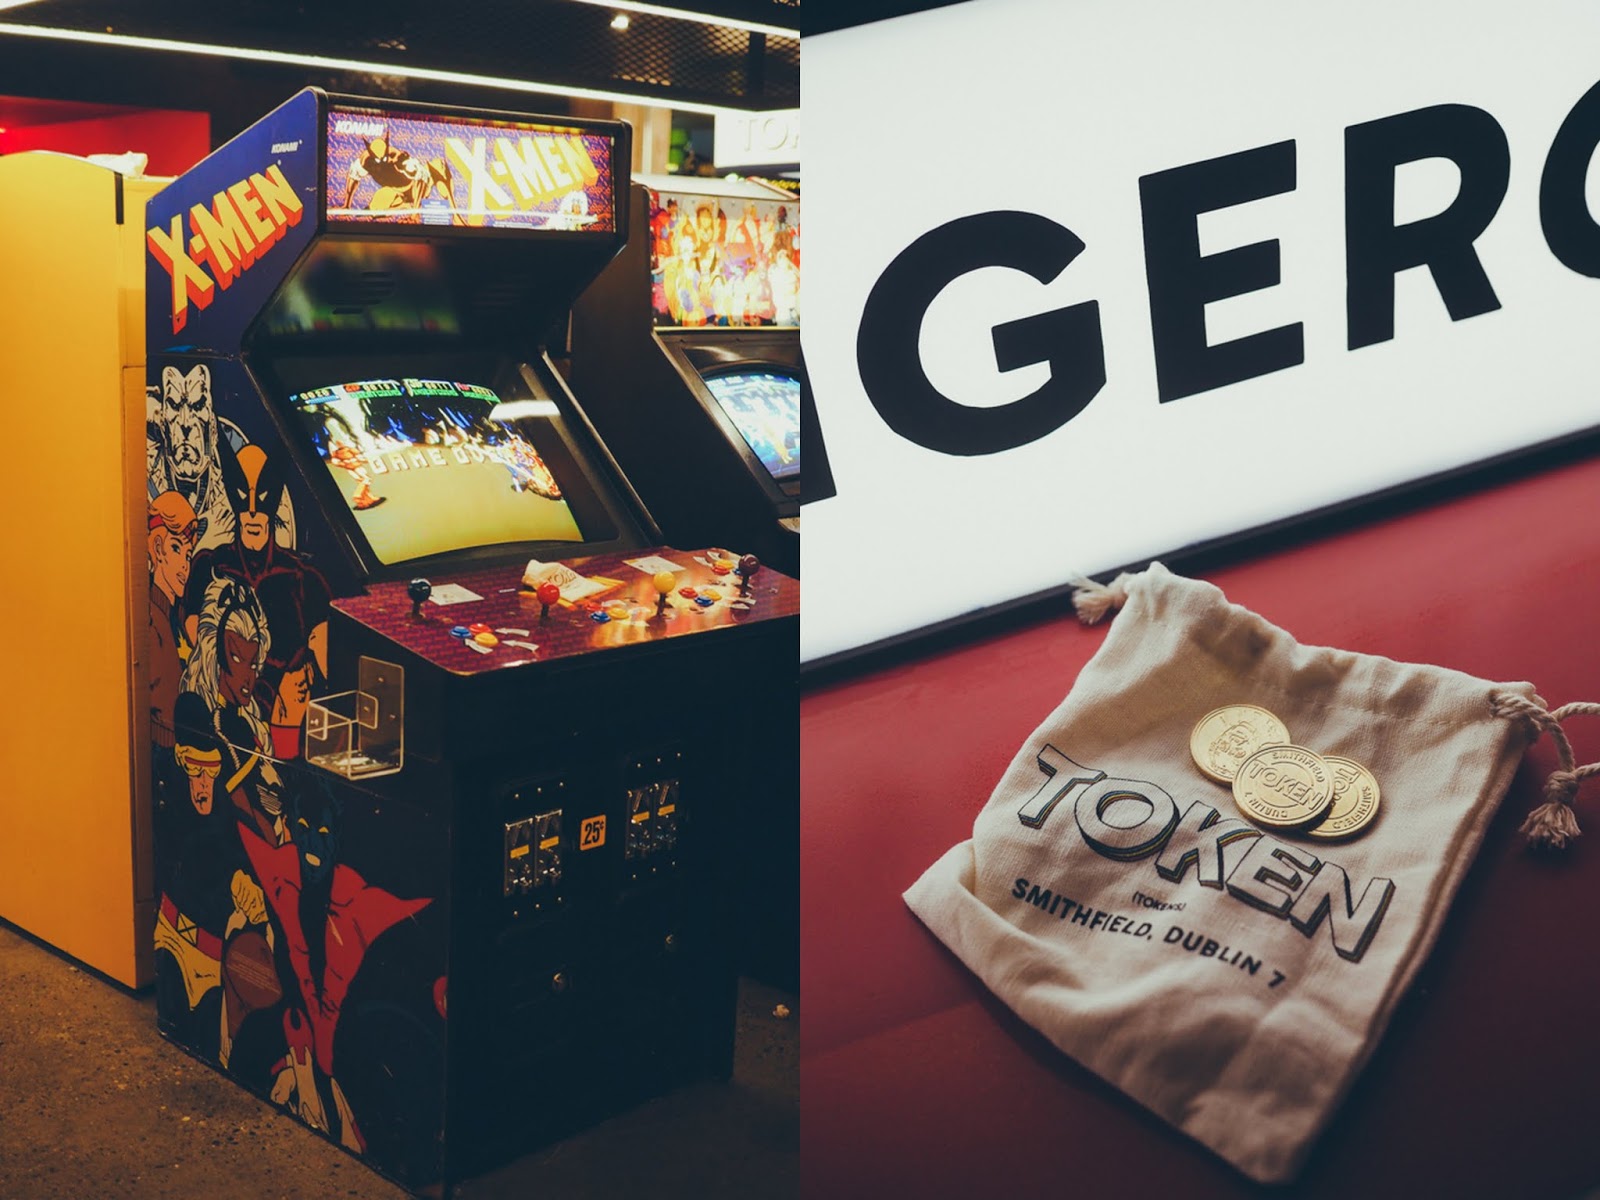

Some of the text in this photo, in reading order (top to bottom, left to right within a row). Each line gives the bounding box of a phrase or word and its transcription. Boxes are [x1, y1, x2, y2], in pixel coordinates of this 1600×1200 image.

[271, 141, 299, 154] KONAMI
[335, 120, 384, 136] KONAMI
[445, 136, 599, 227] X-MEN
[147, 164, 303, 335] X-MEN
[370, 450, 447, 474] GAME
[1250, 760, 1325, 811] TOKEN
[1017, 743, 1397, 964] TOKEN
[1012, 878, 1287, 989] SMITHFIELD, DUBLIN 7
